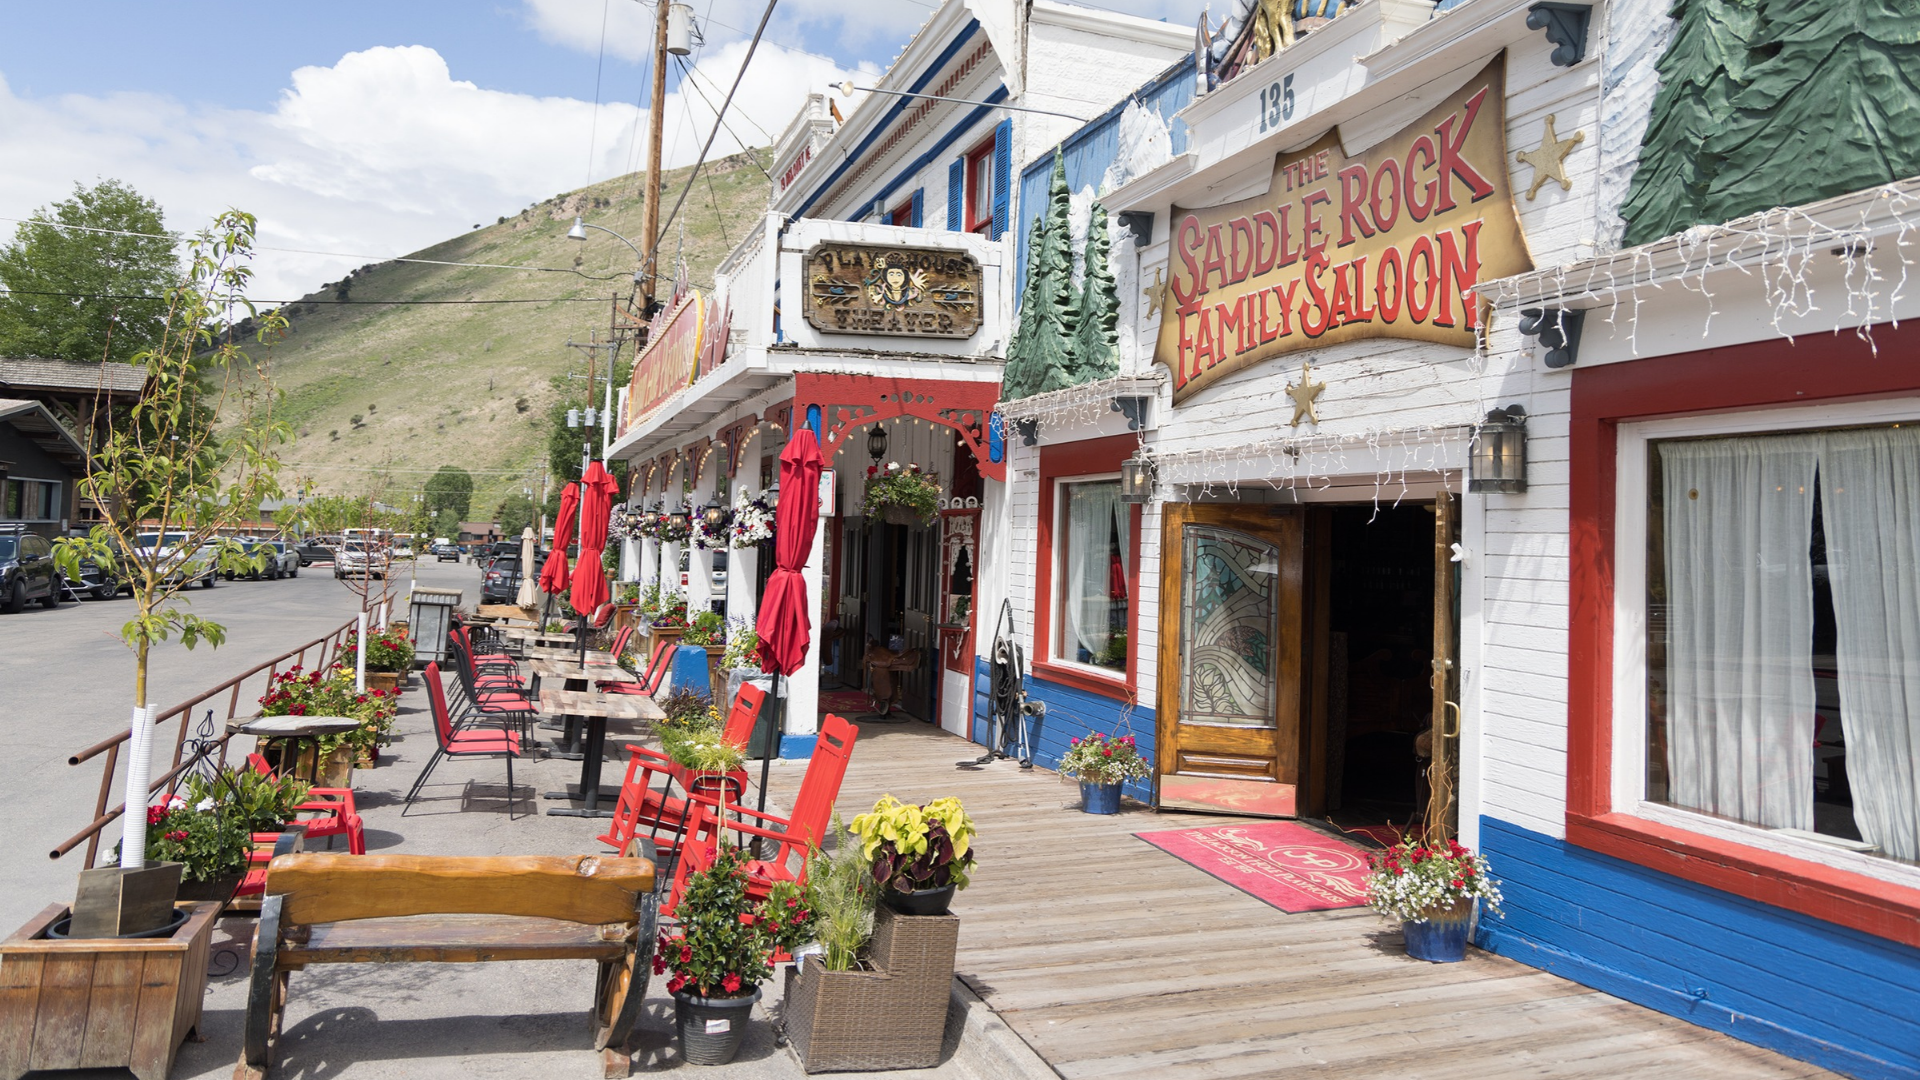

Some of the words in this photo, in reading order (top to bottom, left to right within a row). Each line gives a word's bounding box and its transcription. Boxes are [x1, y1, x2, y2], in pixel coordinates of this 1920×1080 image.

[1259, 73, 1295, 134] 135
[1171, 188, 1331, 310] SADDLE
[1337, 83, 1495, 248] ROCK
[1282, 148, 1329, 193] THE
[834, 307, 953, 334] THEATER
[1175, 276, 1301, 393] FAMILY
[1299, 217, 1484, 338] SALOON
[1245, 859, 1282, 873] HOLE
[1274, 872, 1348, 903] PLAYHOUSE
